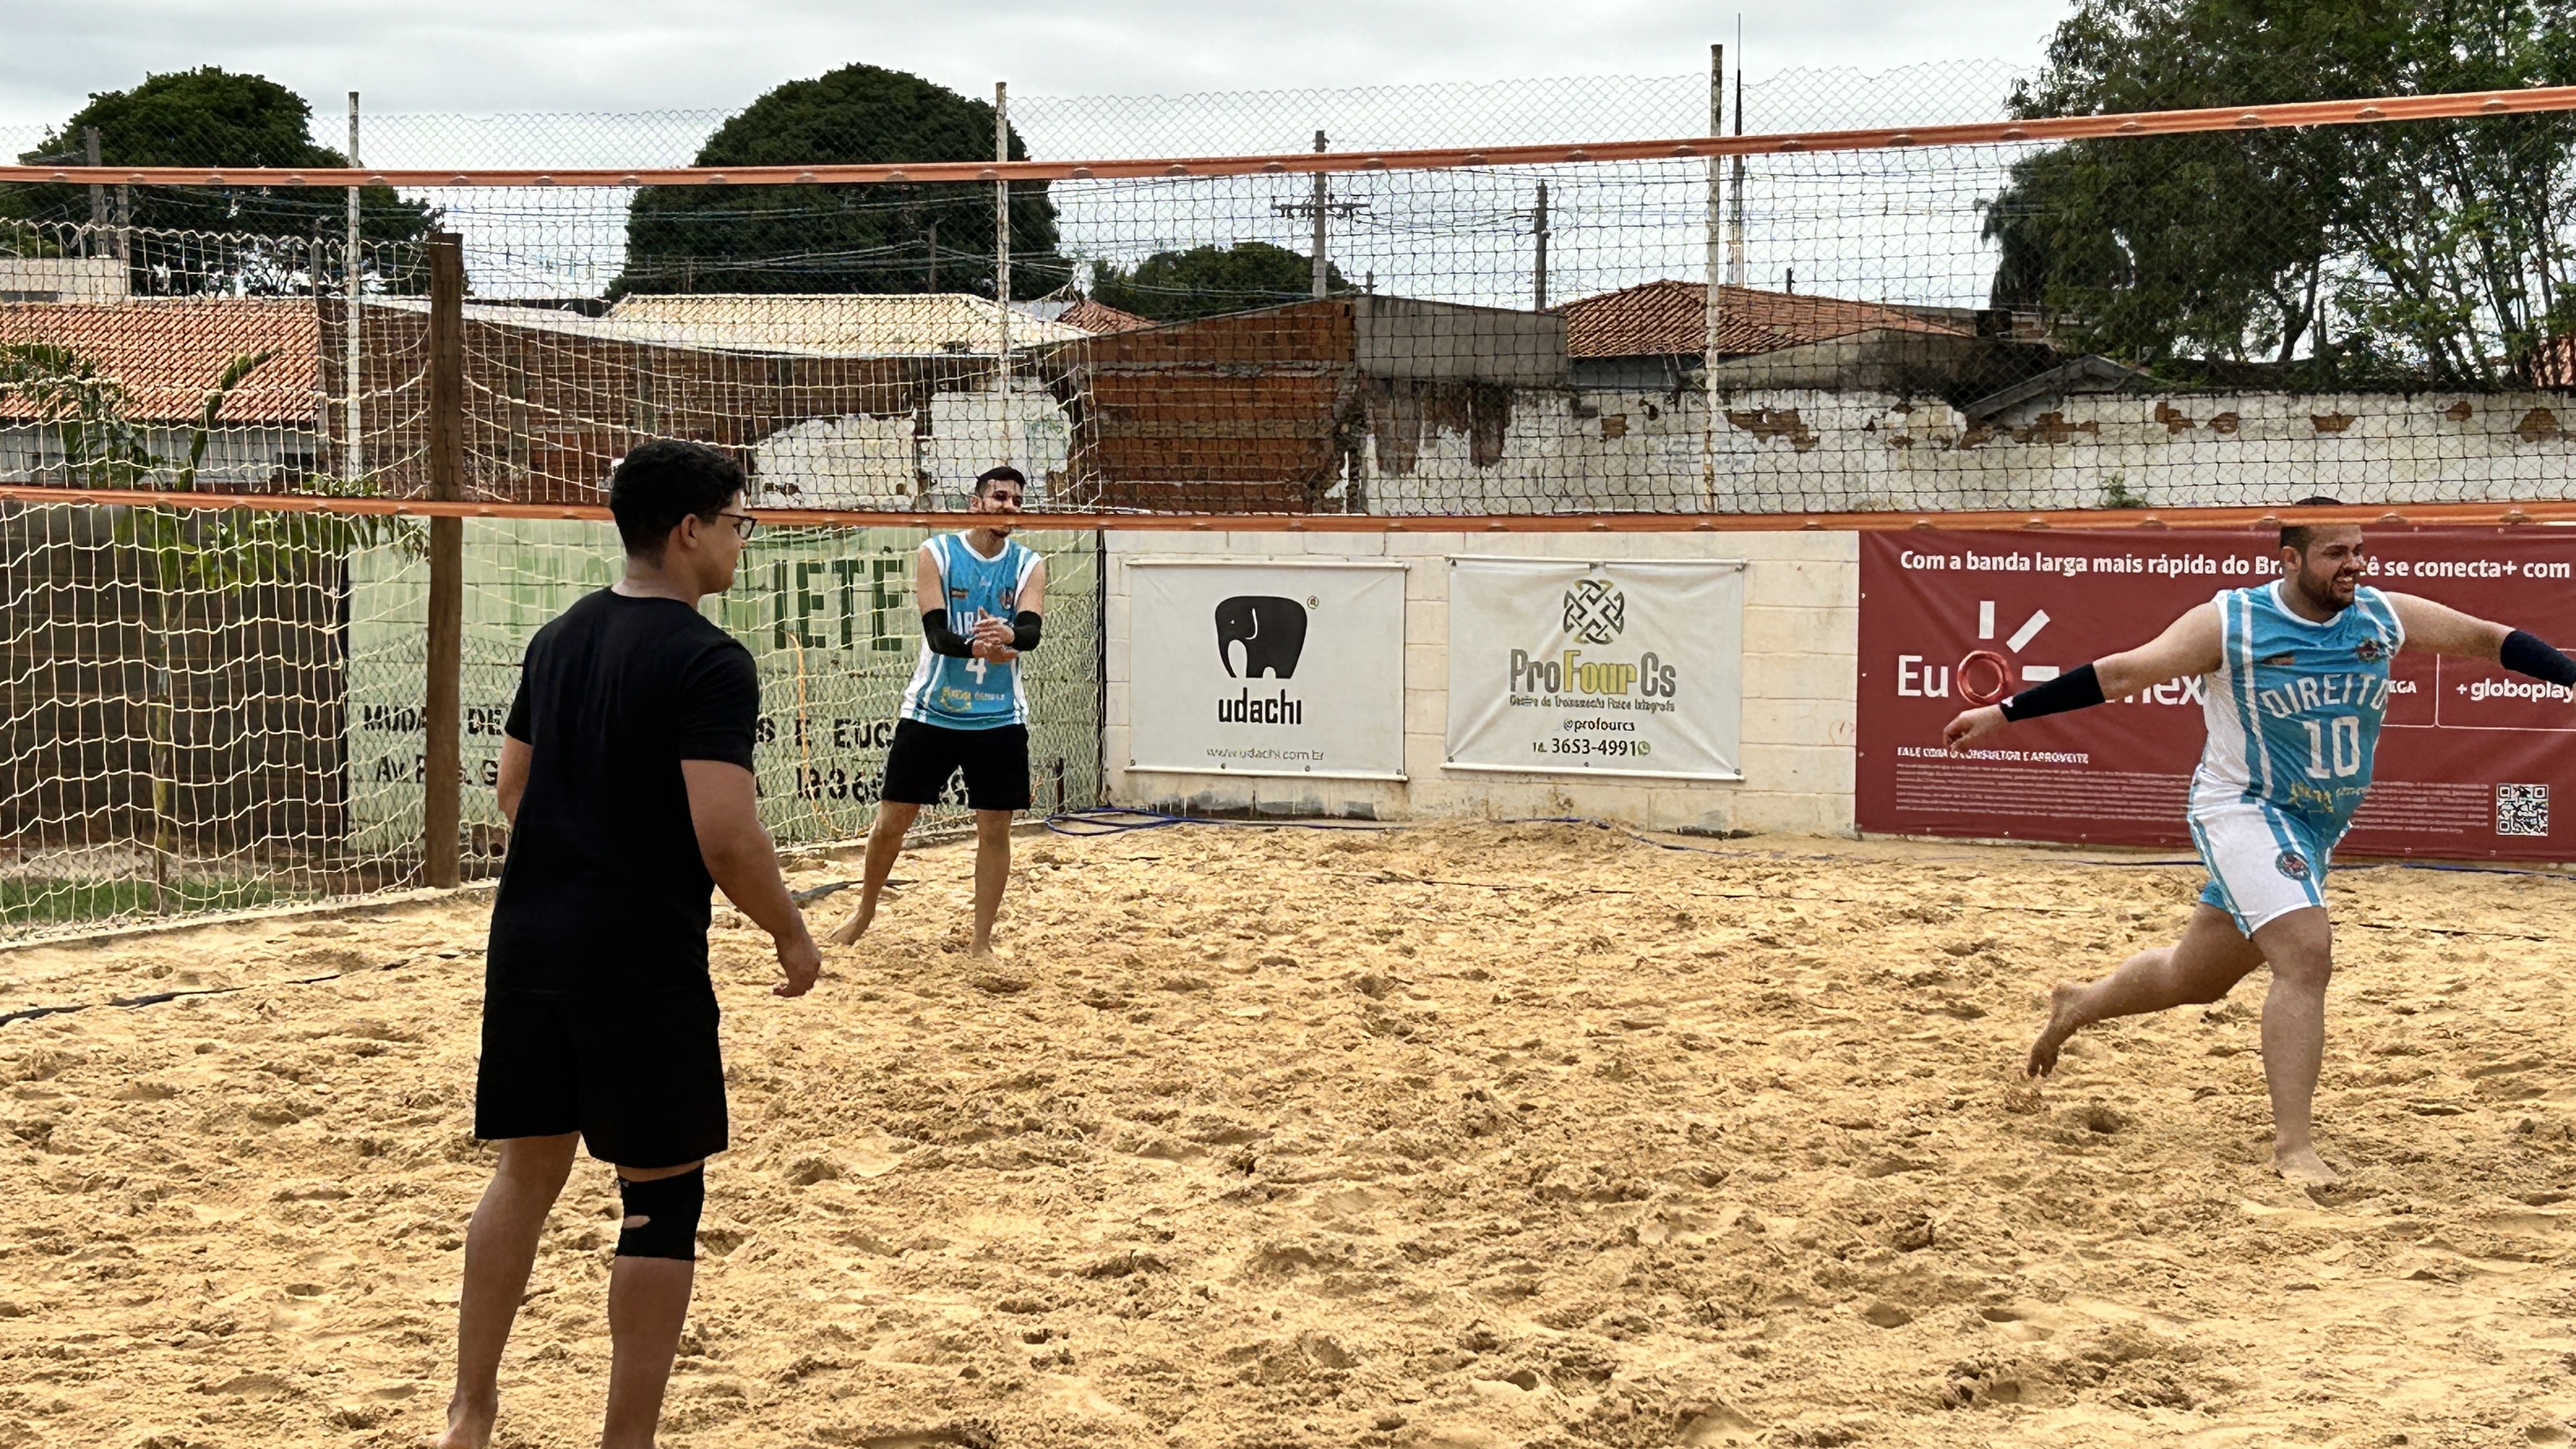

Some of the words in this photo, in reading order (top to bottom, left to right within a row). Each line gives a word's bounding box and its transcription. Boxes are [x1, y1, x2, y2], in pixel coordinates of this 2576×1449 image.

[1901, 550, 1945, 570] Com
[1949, 555, 1961, 570] a
[1966, 551, 2030, 571] banda
[2035, 552, 2087, 577] larga
[2093, 553, 2143, 573] mais
[2148, 554, 2216, 578] rápida
[2222, 555, 2250, 574] do
[2384, 561, 2409, 576] se
[2523, 562, 2570, 578] com
[965, 657, 987, 685] 4
[1897, 654, 1949, 698] Eu
[1218, 687, 1302, 725] udachi
[2258, 673, 2389, 719] DIREITO
[1551, 737, 1636, 757] 3653-4991
[2302, 716, 2360, 779] 10
